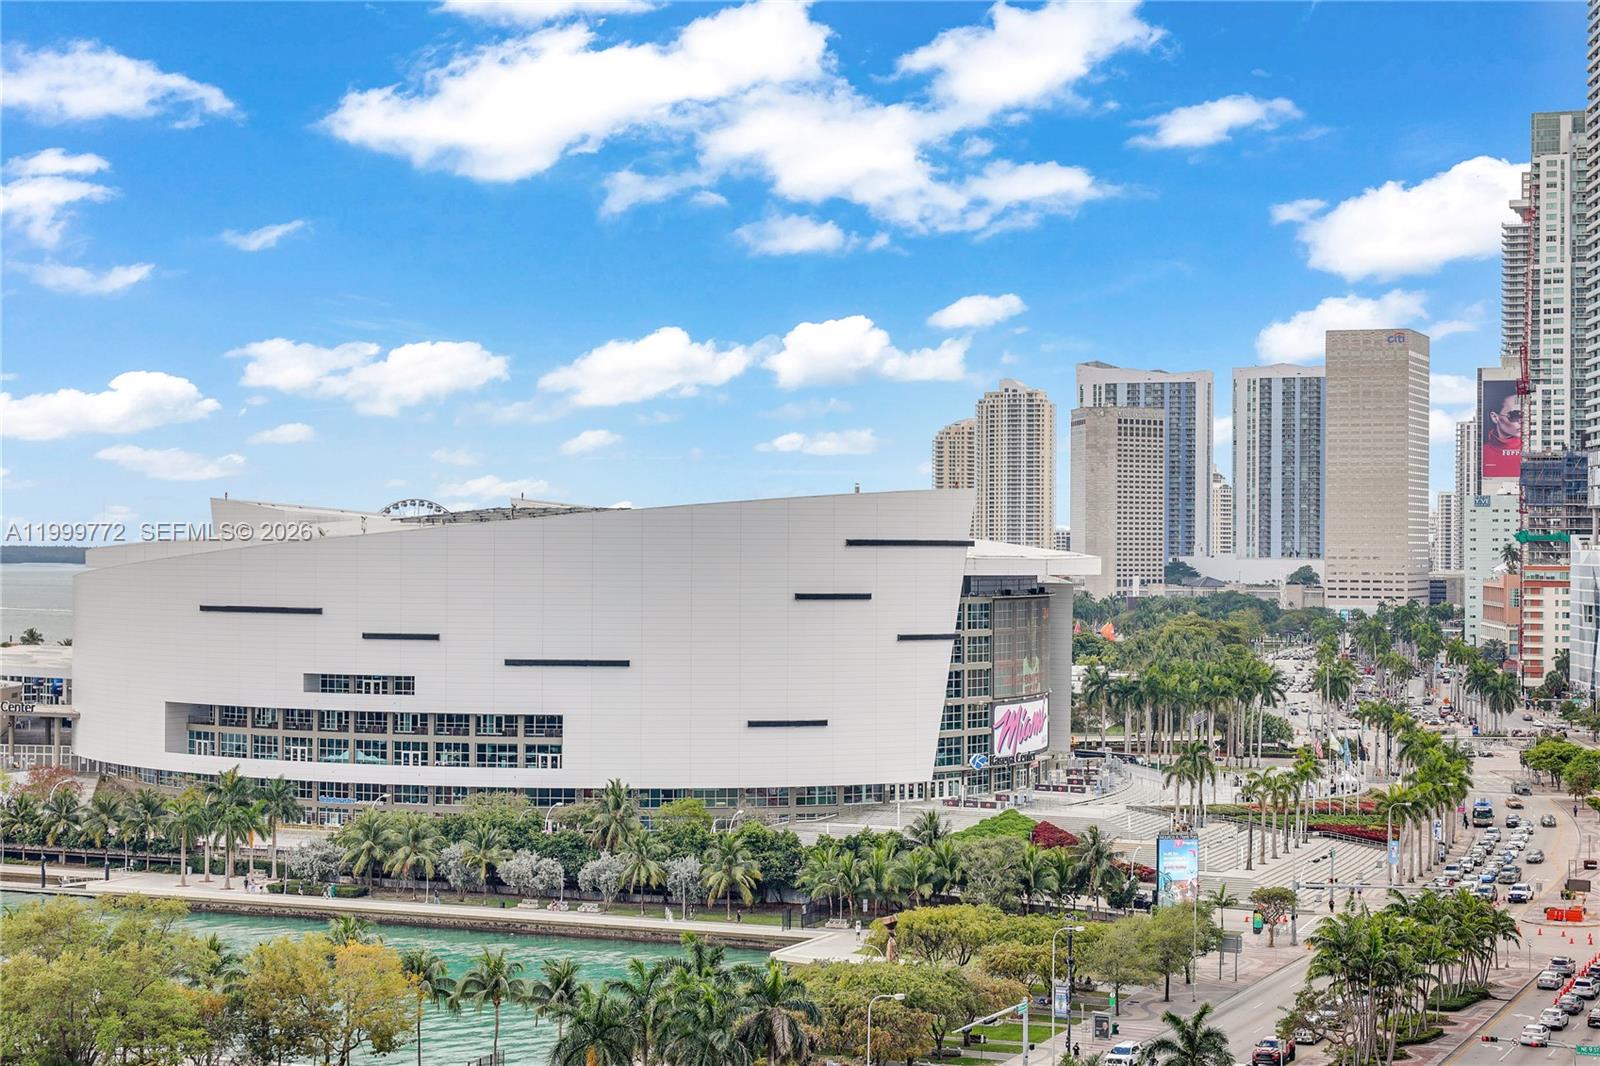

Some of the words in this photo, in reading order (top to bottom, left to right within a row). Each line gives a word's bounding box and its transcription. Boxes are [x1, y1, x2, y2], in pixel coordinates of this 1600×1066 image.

[1387, 333, 1405, 343] citi
[1, 701, 35, 713] Center
[992, 704, 1046, 757] Miami
[989, 754, 1015, 768] Kaseya
[1015, 751, 1036, 763] Center
